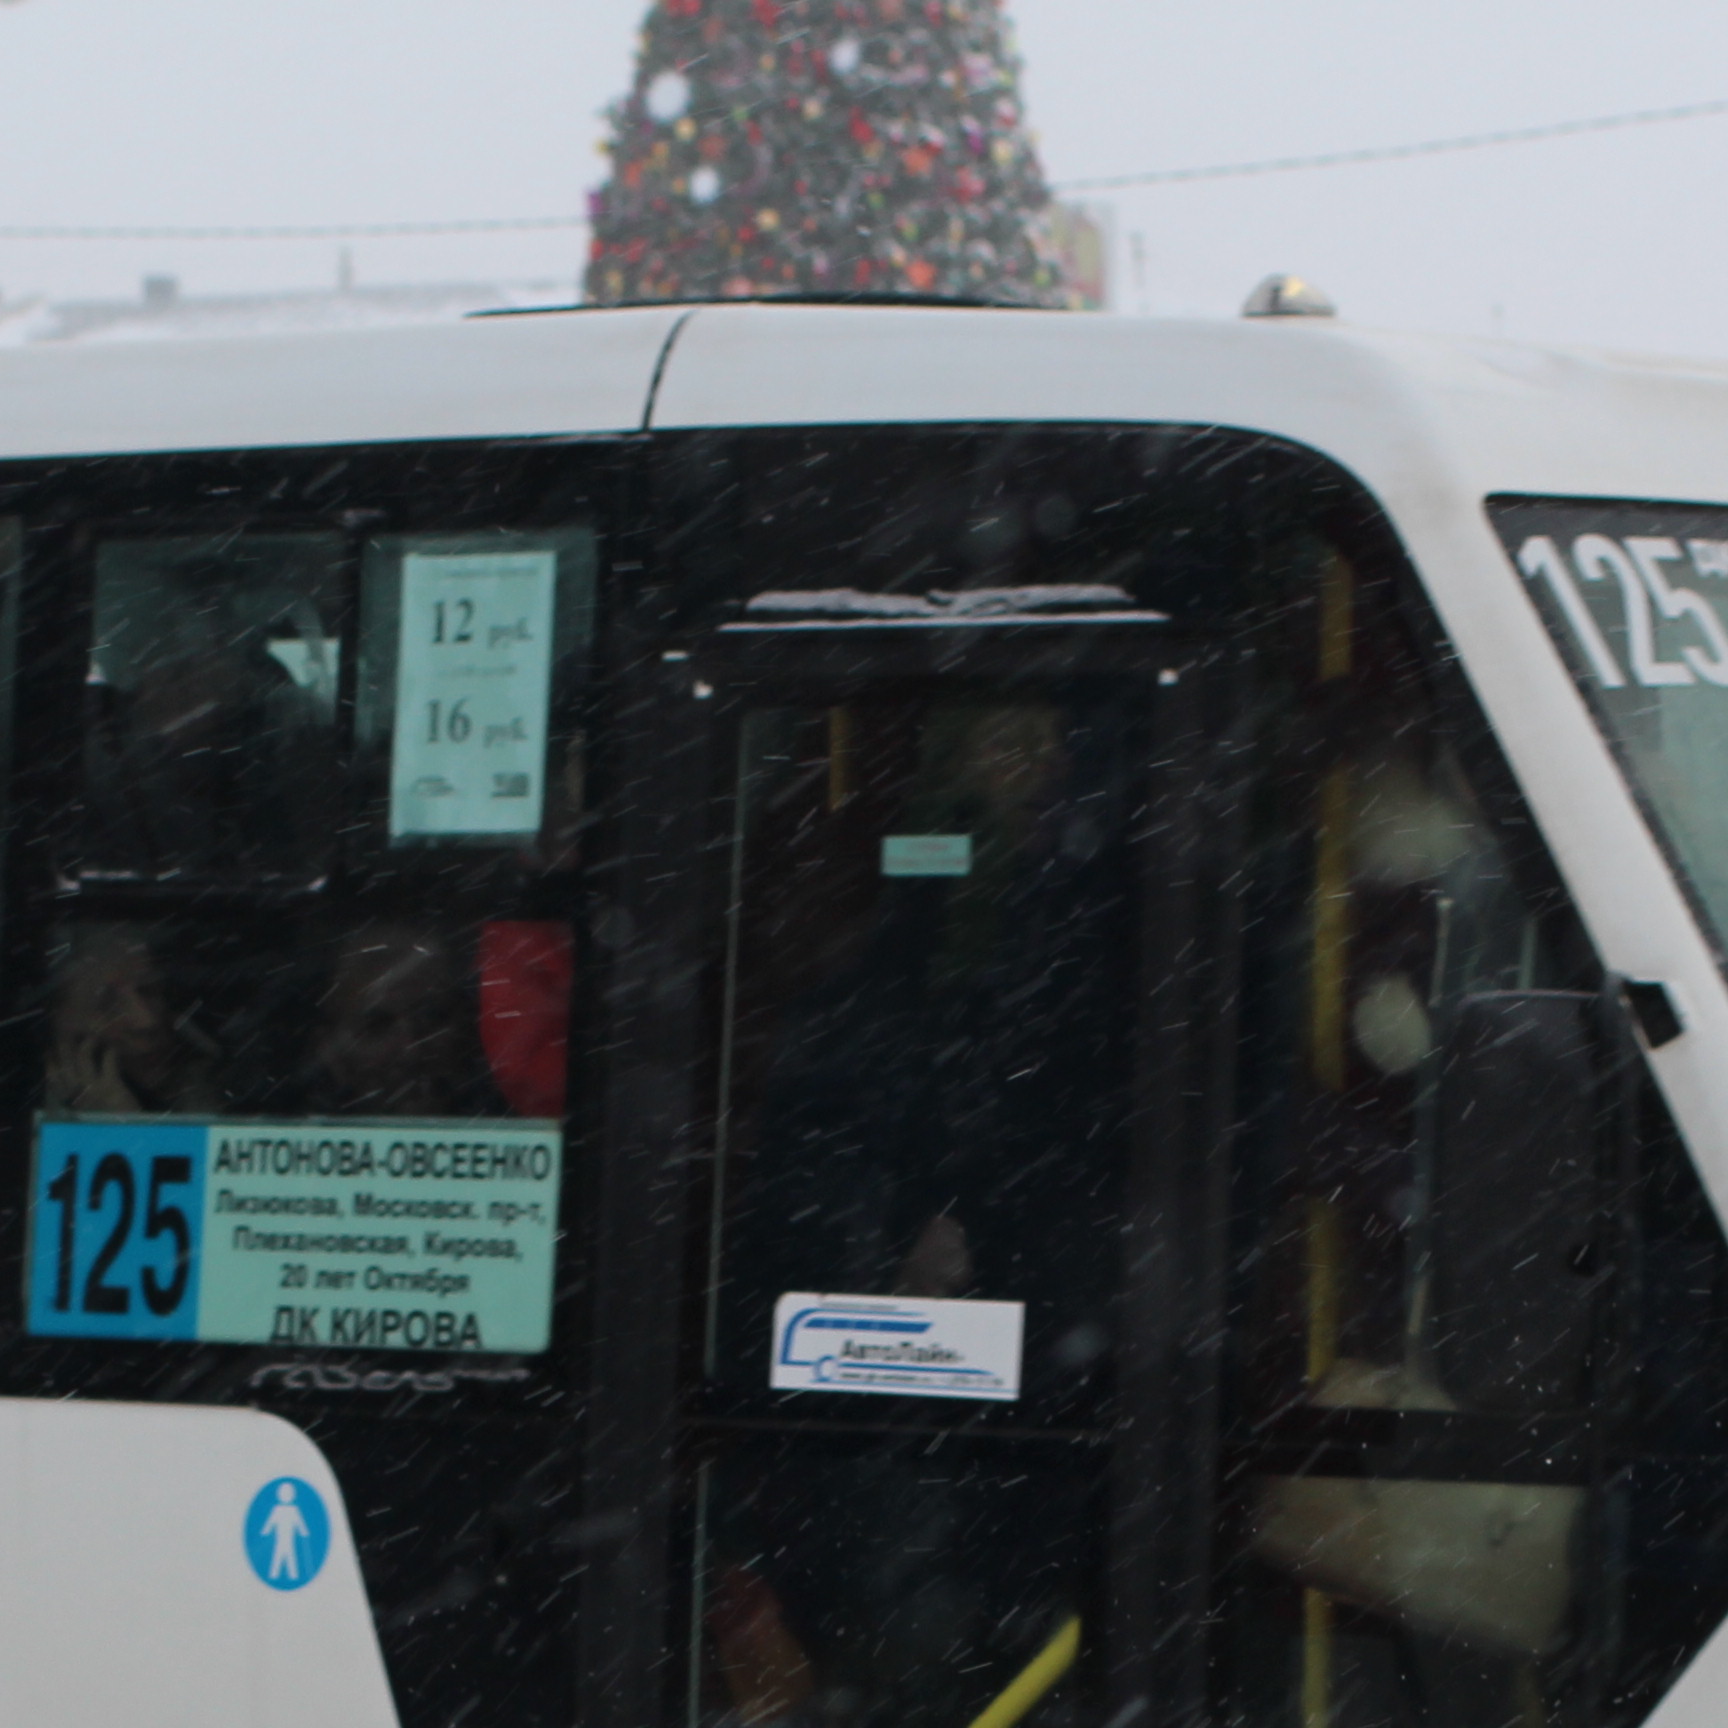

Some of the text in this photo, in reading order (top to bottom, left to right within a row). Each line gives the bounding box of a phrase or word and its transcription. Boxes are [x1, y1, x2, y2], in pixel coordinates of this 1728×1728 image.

[428, 597, 476, 645] 12
[424, 696, 472, 745] 16
[214, 1138, 552, 1181] АНТОНОВА-ОВСЕЕНКО
[47, 1152, 193, 1318] 125
[232, 1225, 524, 1262] Плехановская, Кирова,
[279, 1262, 470, 1298] 20 лет Октября
[269, 1304, 484, 1349] ДК КИРОВА
